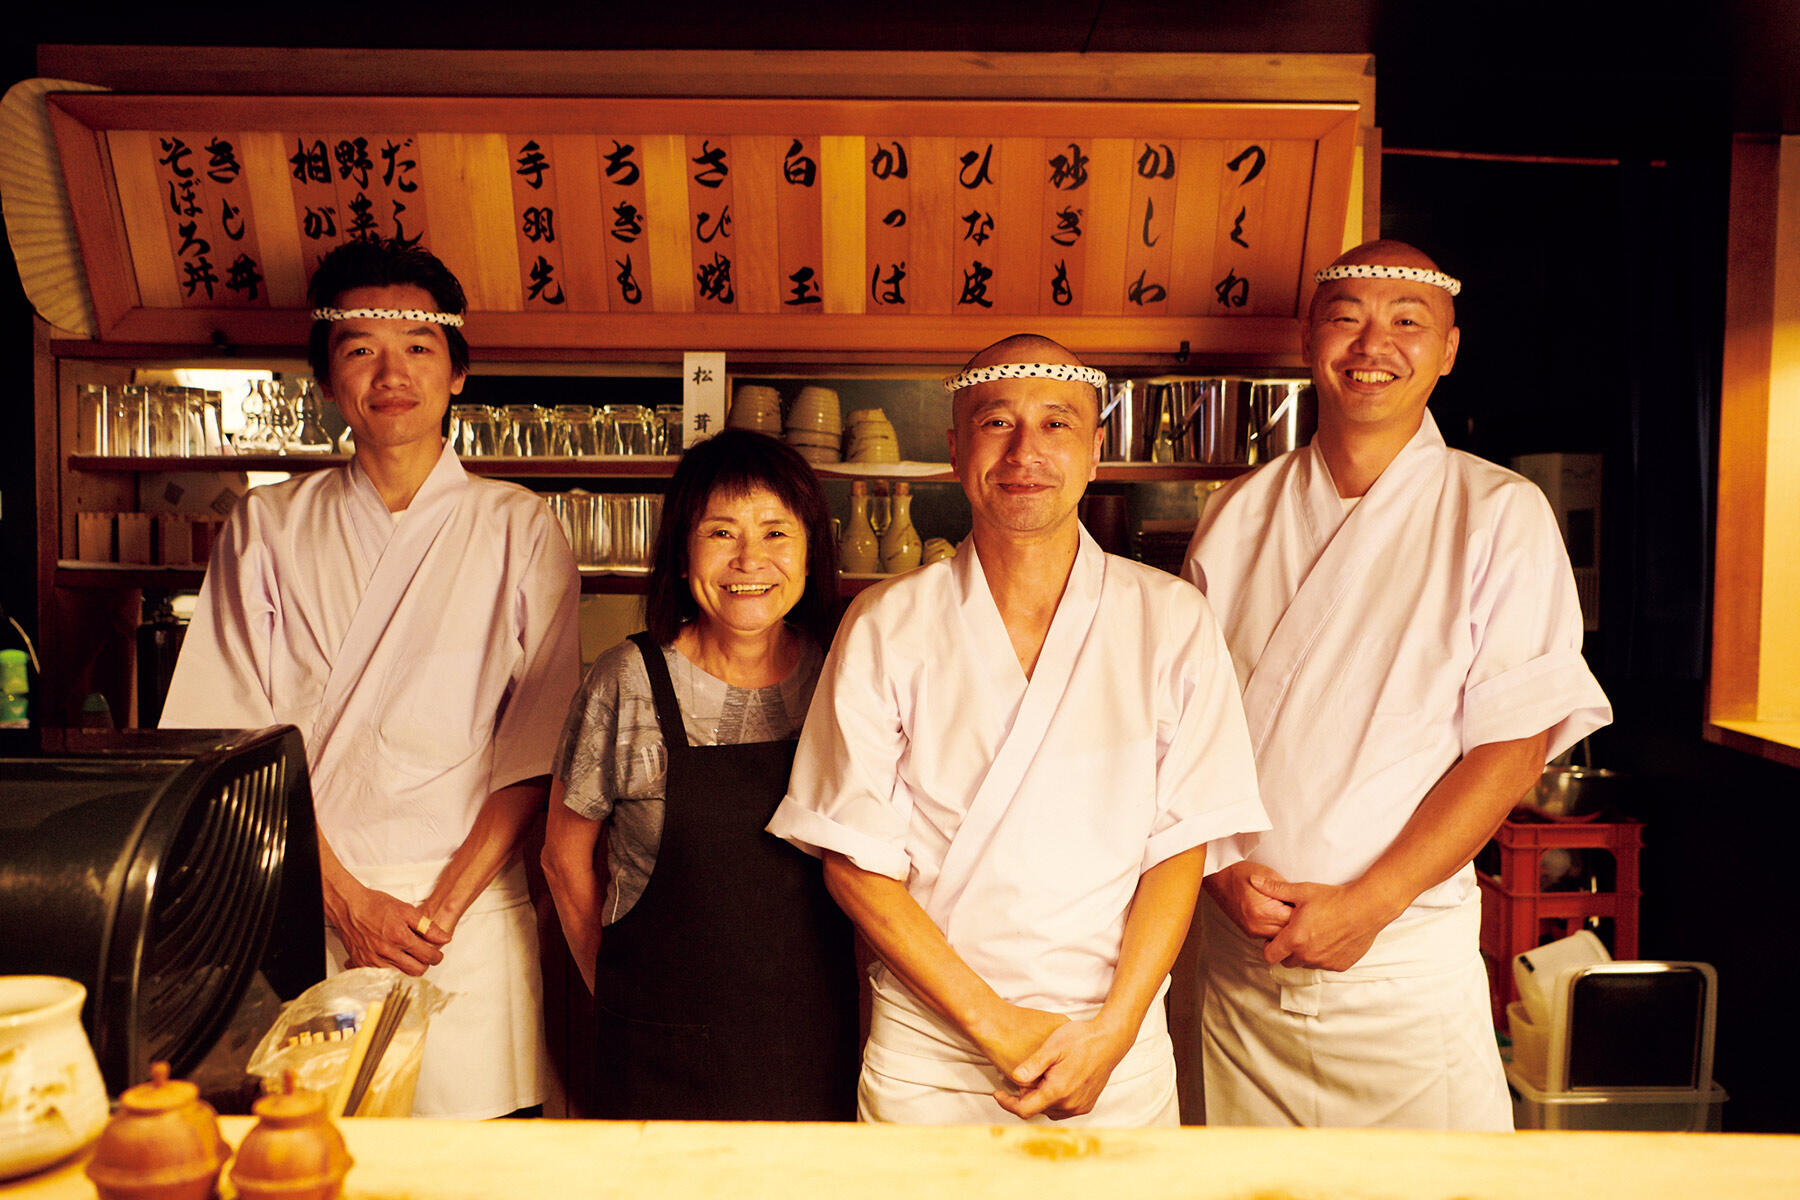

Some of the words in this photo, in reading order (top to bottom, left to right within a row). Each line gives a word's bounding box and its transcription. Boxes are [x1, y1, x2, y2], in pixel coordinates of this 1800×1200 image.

[289, 138, 336, 262] 相が
[516, 140, 565, 305] 手羽先
[604, 140, 643, 304] ちぎも
[784, 139, 822, 305] 白玉
[959, 143, 995, 308] ひな皮
[1049, 143, 1090, 306] 砂ぎも
[1129, 143, 1175, 306] かしわ
[1215, 145, 1266, 308] つくね
[692, 366, 713, 433] 松茸
